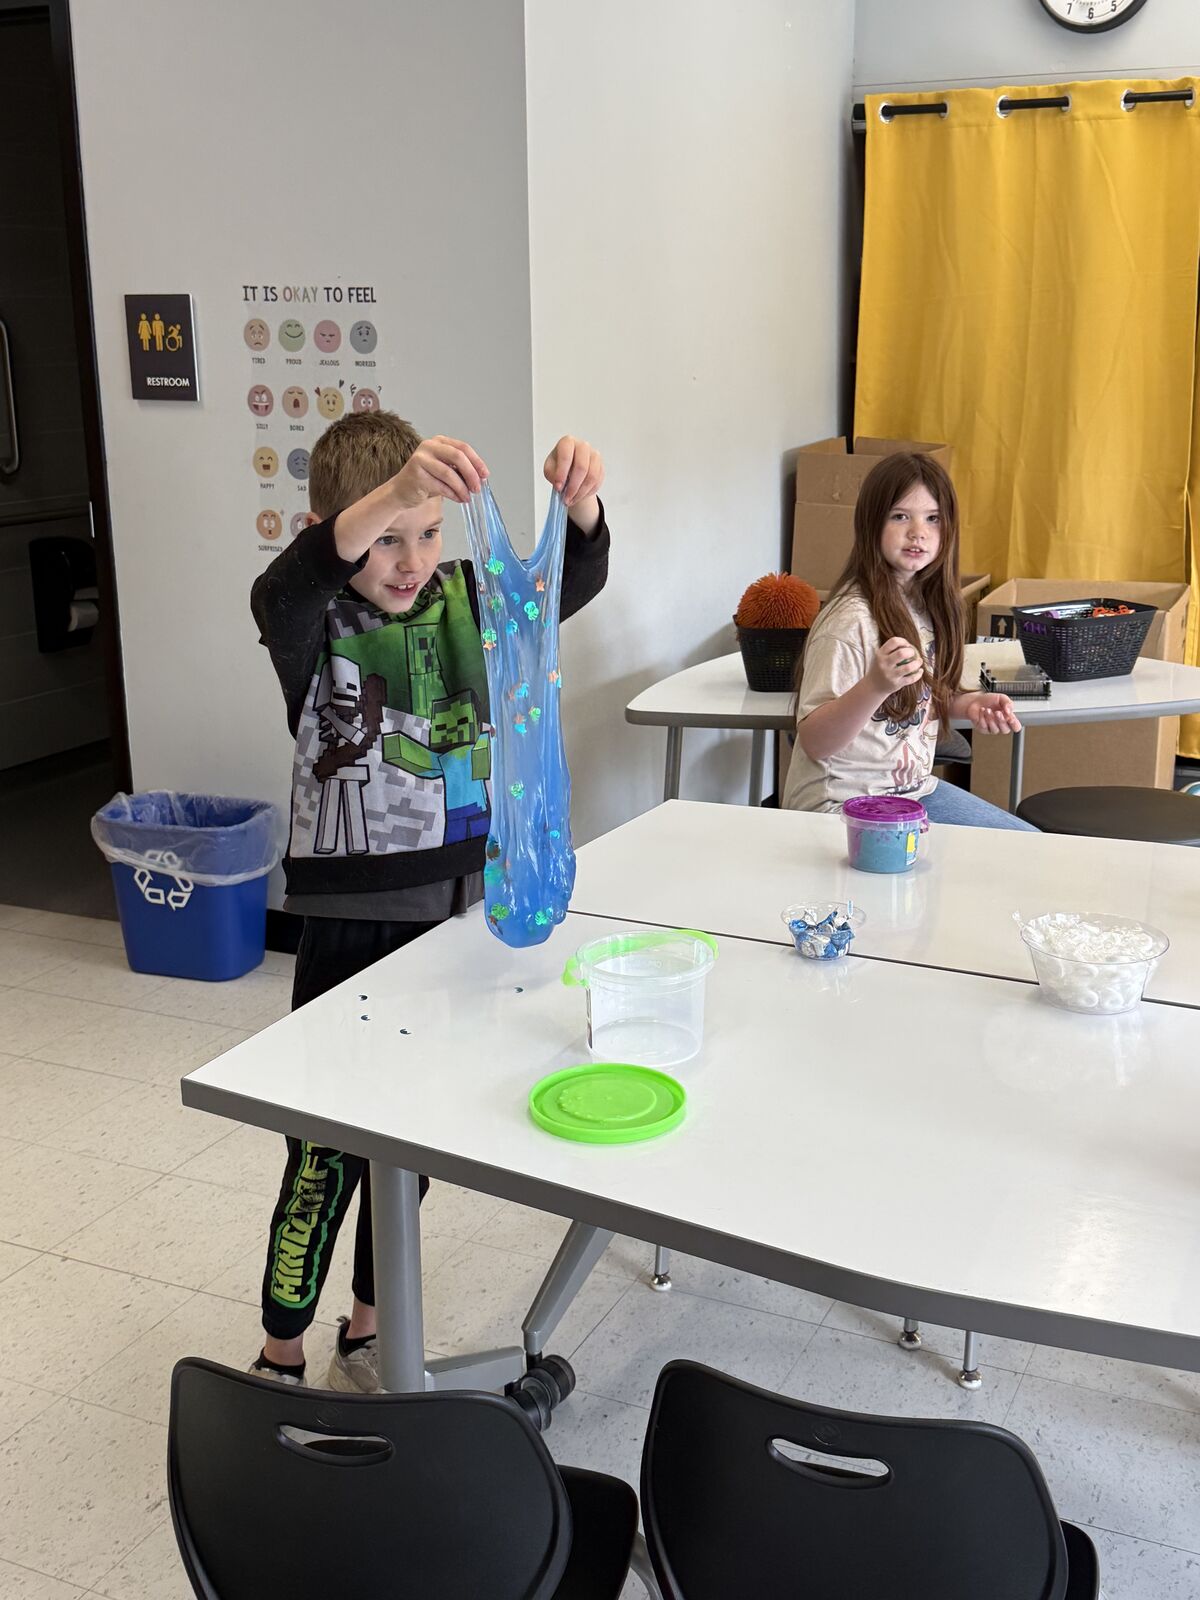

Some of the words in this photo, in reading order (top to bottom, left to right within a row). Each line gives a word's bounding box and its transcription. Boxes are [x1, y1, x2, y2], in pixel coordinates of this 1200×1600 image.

[1067, 2, 1072, 15] 7
[1110, 0, 1117, 12] 5
[1087, 7, 1094, 20] 6
[242, 285, 258, 302] IT
[263, 285, 278, 302] IS
[282, 286, 318, 303] OKAY
[323, 287, 343, 303] TO
[347, 287, 377, 303] FEEL
[252, 357, 266, 365] TIRED
[319, 359, 340, 367] JEALOUS
[354, 360, 377, 368] WORRIED
[146, 376, 190, 387] RESTROOM
